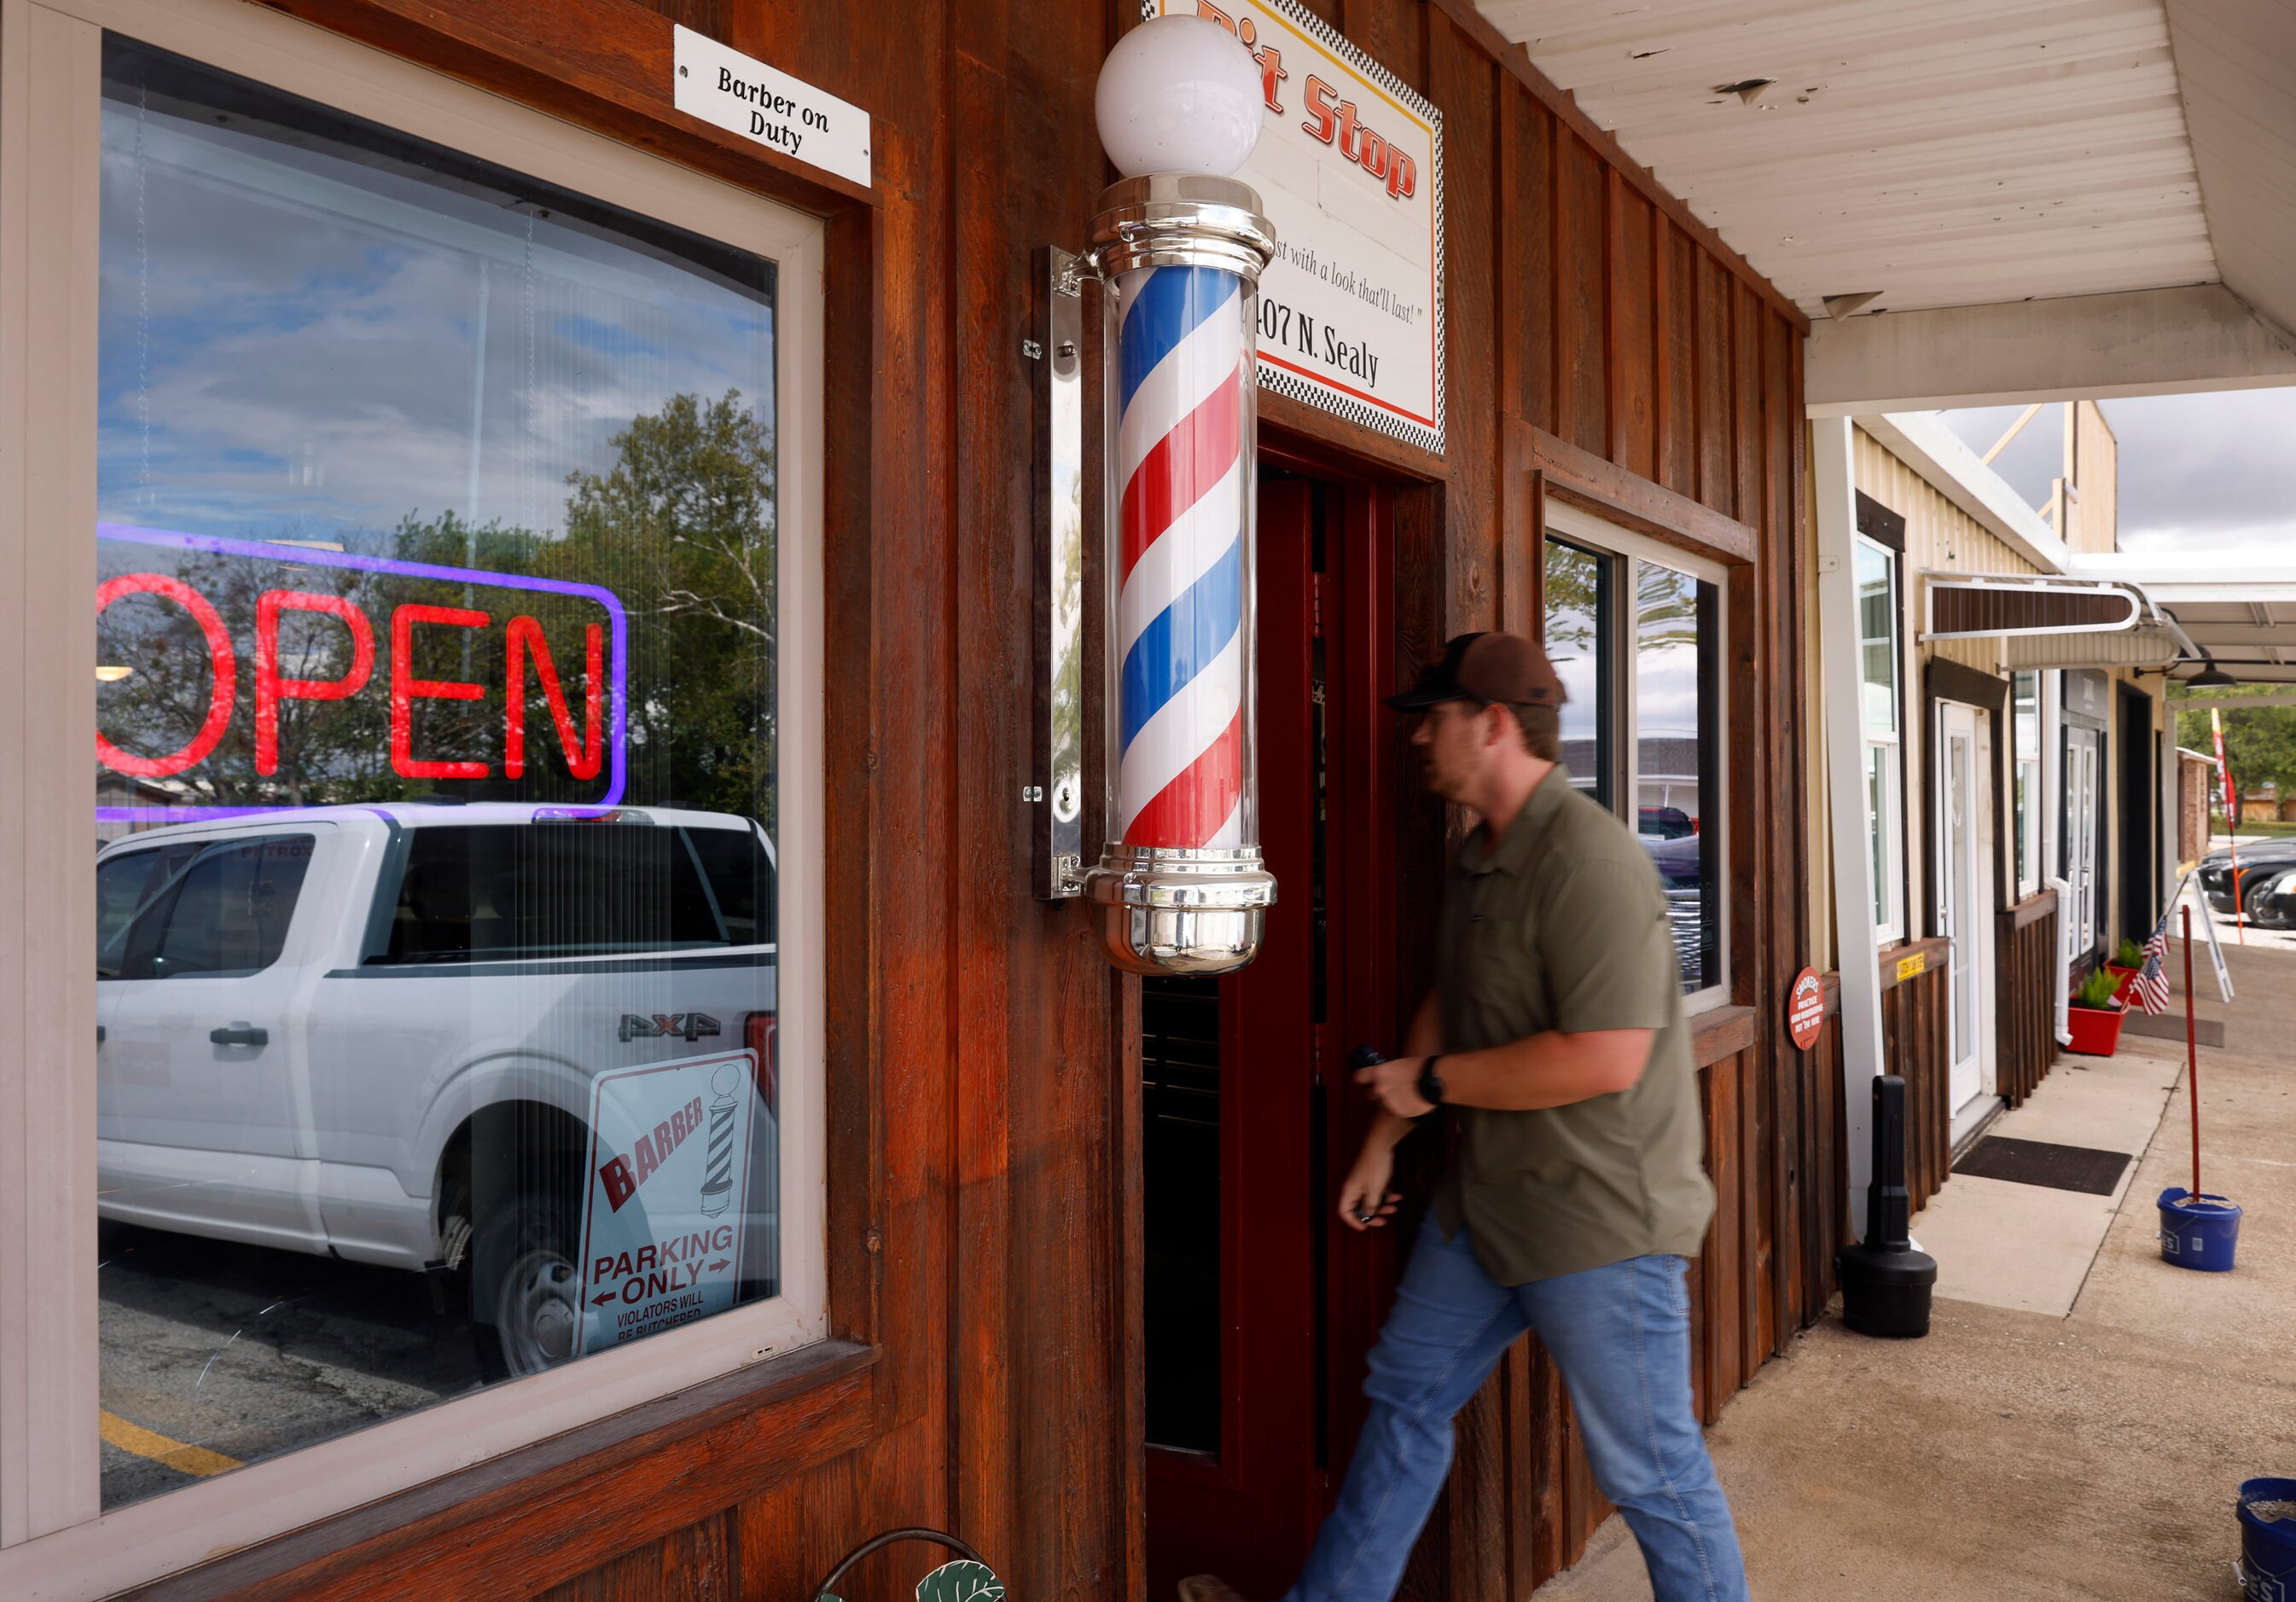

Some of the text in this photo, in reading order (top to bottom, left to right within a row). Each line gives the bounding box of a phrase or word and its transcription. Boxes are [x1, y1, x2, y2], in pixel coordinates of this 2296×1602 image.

[718, 67, 829, 133] Barber on
[749, 110, 803, 155] Duty
[1301, 74, 1417, 200] Stop
[1290, 247, 1317, 276] with
[1320, 263, 1328, 280] a
[1331, 261, 1356, 296] look
[1358, 278, 1390, 312] that'll
[1297, 311, 1318, 358] N.
[1324, 325, 1379, 388] Sealy
[96, 572, 602, 781] OPEN
[1796, 975, 1819, 1000] SMOKERS
[599, 1095, 704, 1213] BARBER
[593, 1225, 733, 1286] PARKING
[621, 1258, 706, 1304] ONLY
[617, 1291, 704, 1328] VIOLATORS WILL
